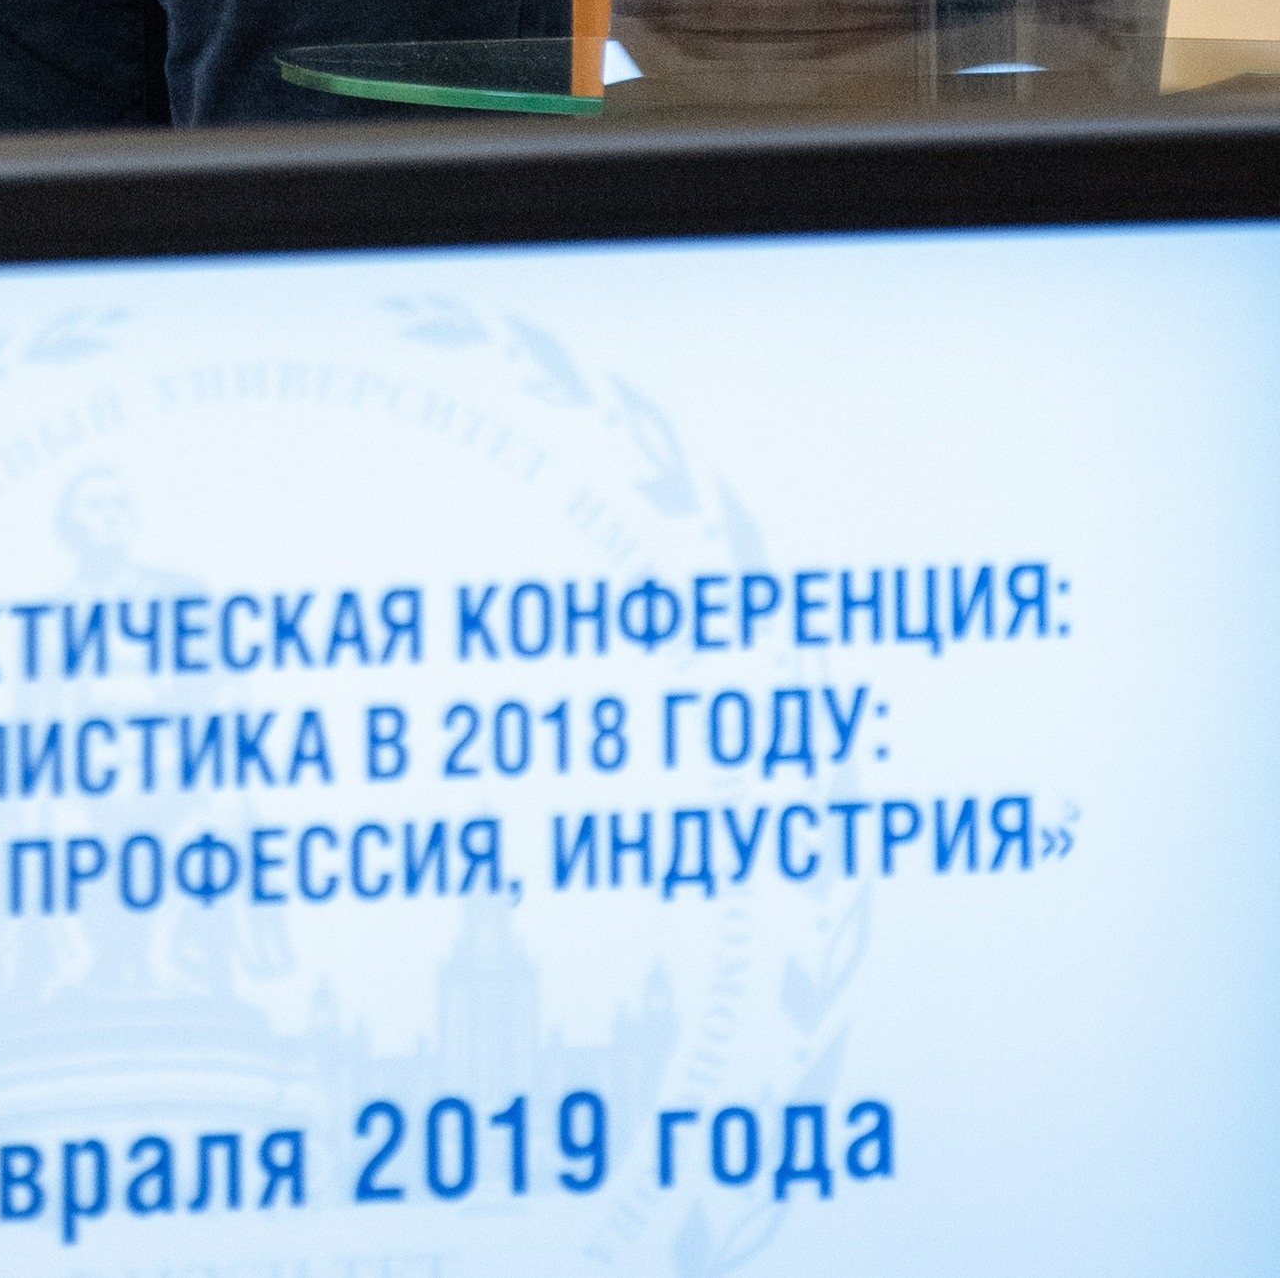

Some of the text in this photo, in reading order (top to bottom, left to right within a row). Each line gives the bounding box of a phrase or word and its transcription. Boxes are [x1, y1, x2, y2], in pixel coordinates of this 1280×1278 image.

[456, 561, 1074, 665] КОНФЕРЕНЦИЯ:
[365, 700, 409, 784] В
[440, 694, 631, 782] 2018
[661, 684, 893, 784] ГОДУ:
[6, 815, 525, 920] ПРОФЕССИЯ,
[550, 794, 1078, 903] ИНДУСТРИЯ»
[351, 1089, 611, 1205] 2019
[656, 1096, 898, 1203] года
